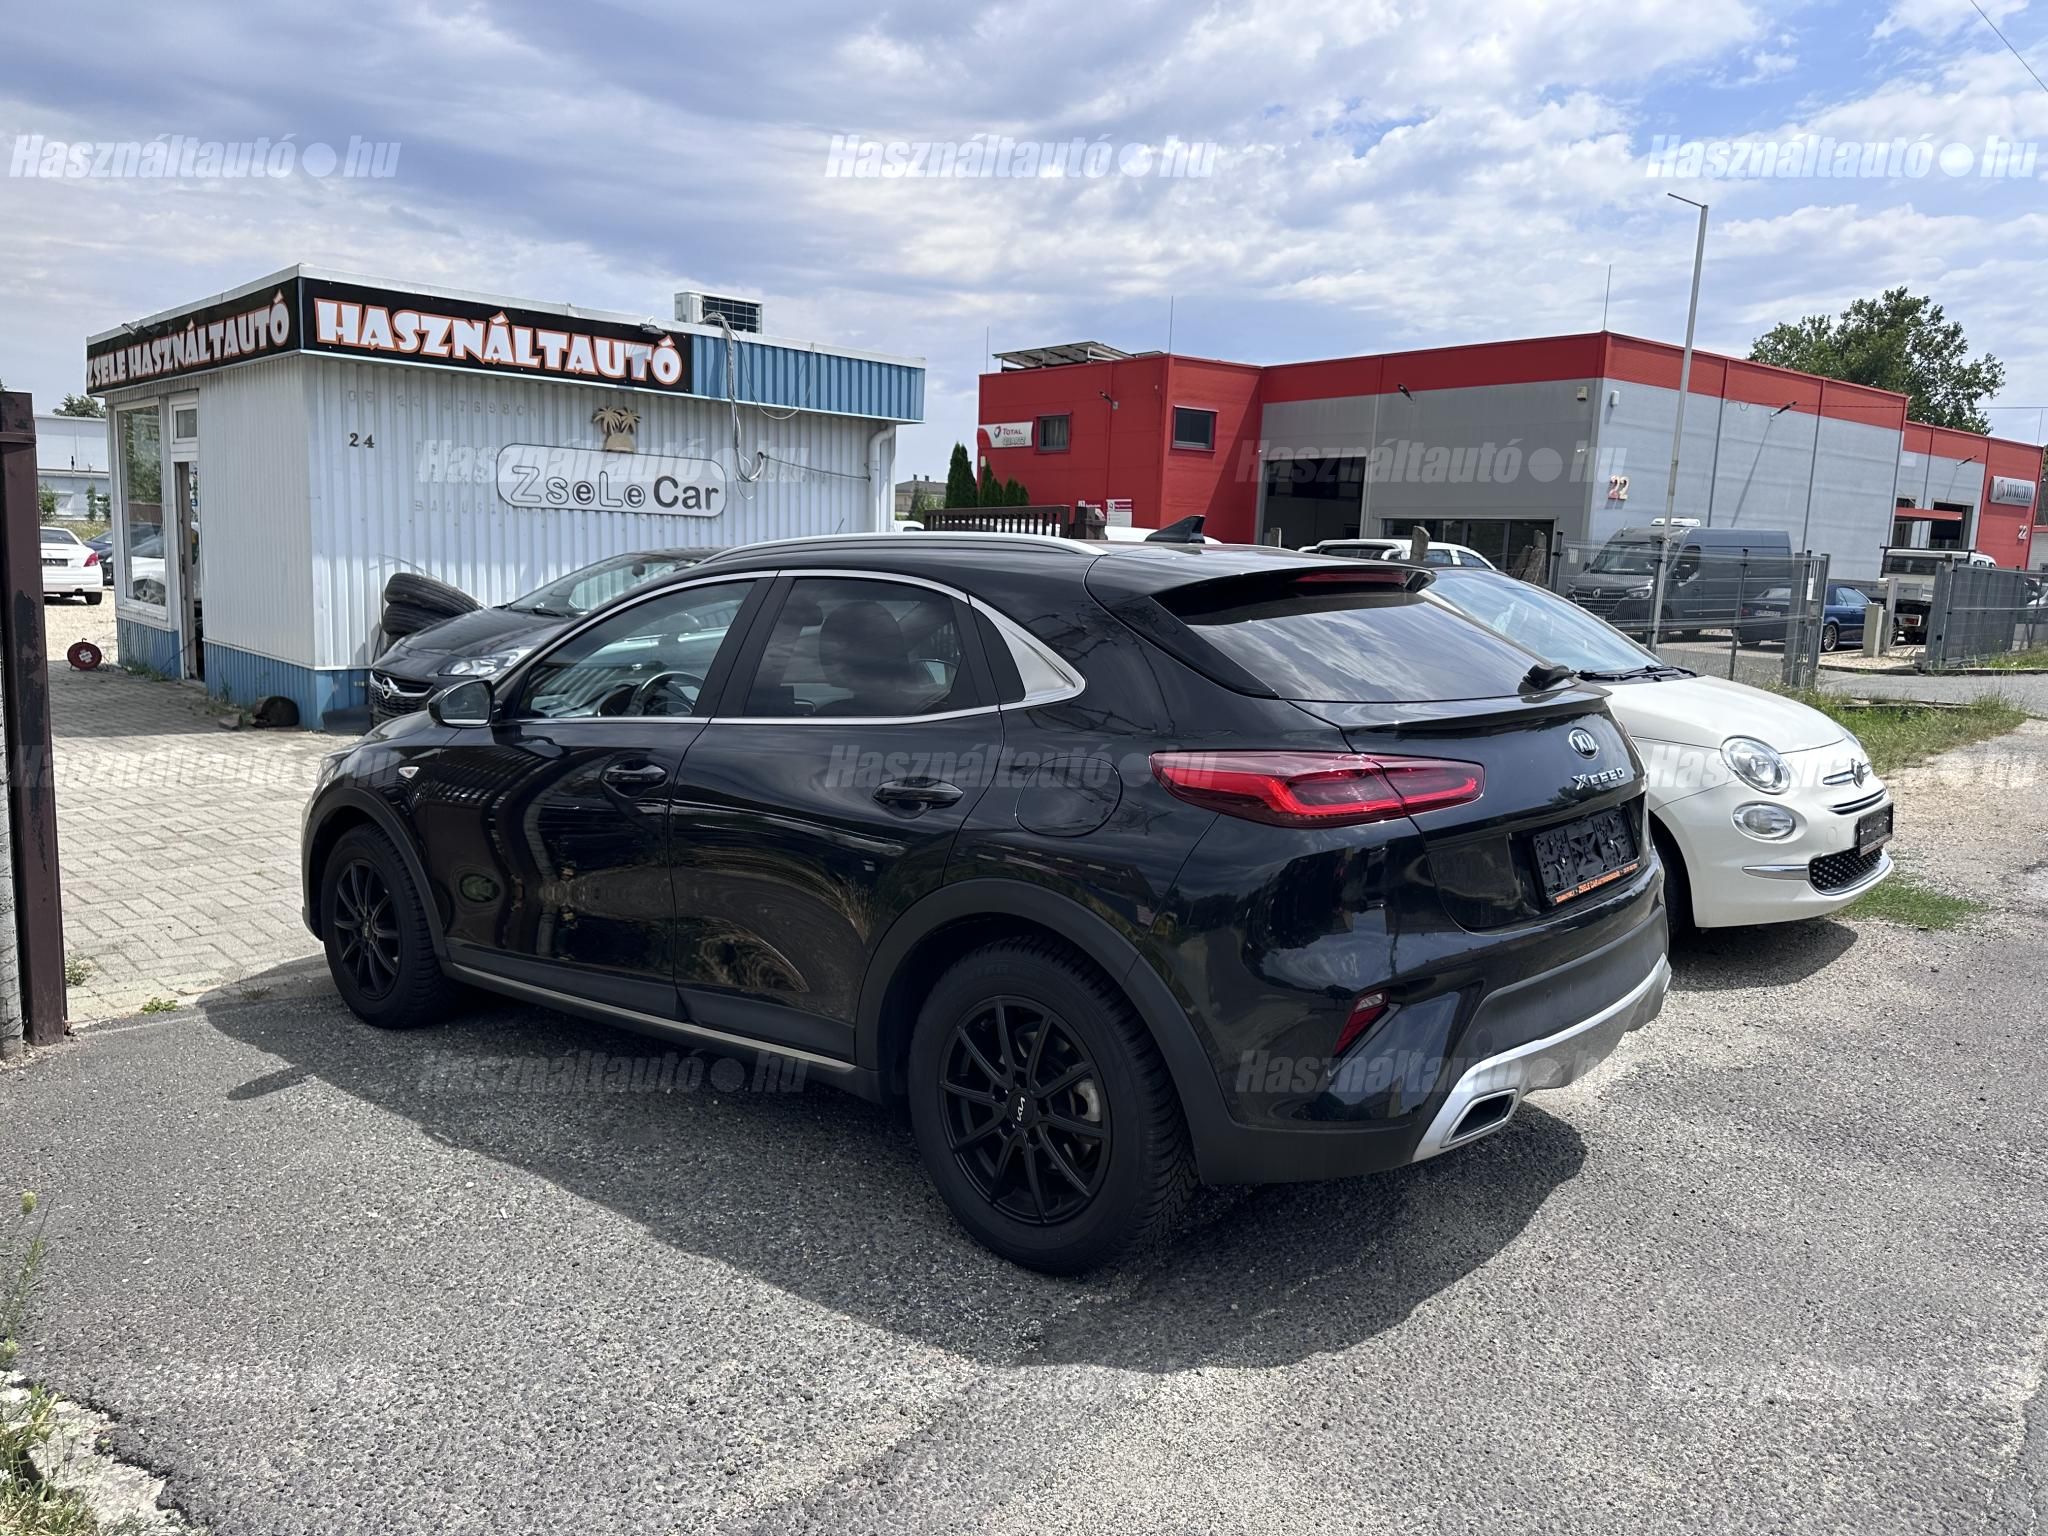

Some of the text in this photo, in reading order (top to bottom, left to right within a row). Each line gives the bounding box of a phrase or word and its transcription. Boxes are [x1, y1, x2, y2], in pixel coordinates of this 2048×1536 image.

[127, 288, 290, 376] HASZNÁLTAUTÓ
[314, 297, 682, 385] HASZNÁLTAUTÓ
[349, 432, 376, 449] 24
[653, 475, 719, 510] Car
[1608, 475, 1629, 501] 22
[1571, 767, 1625, 790] XCEED
